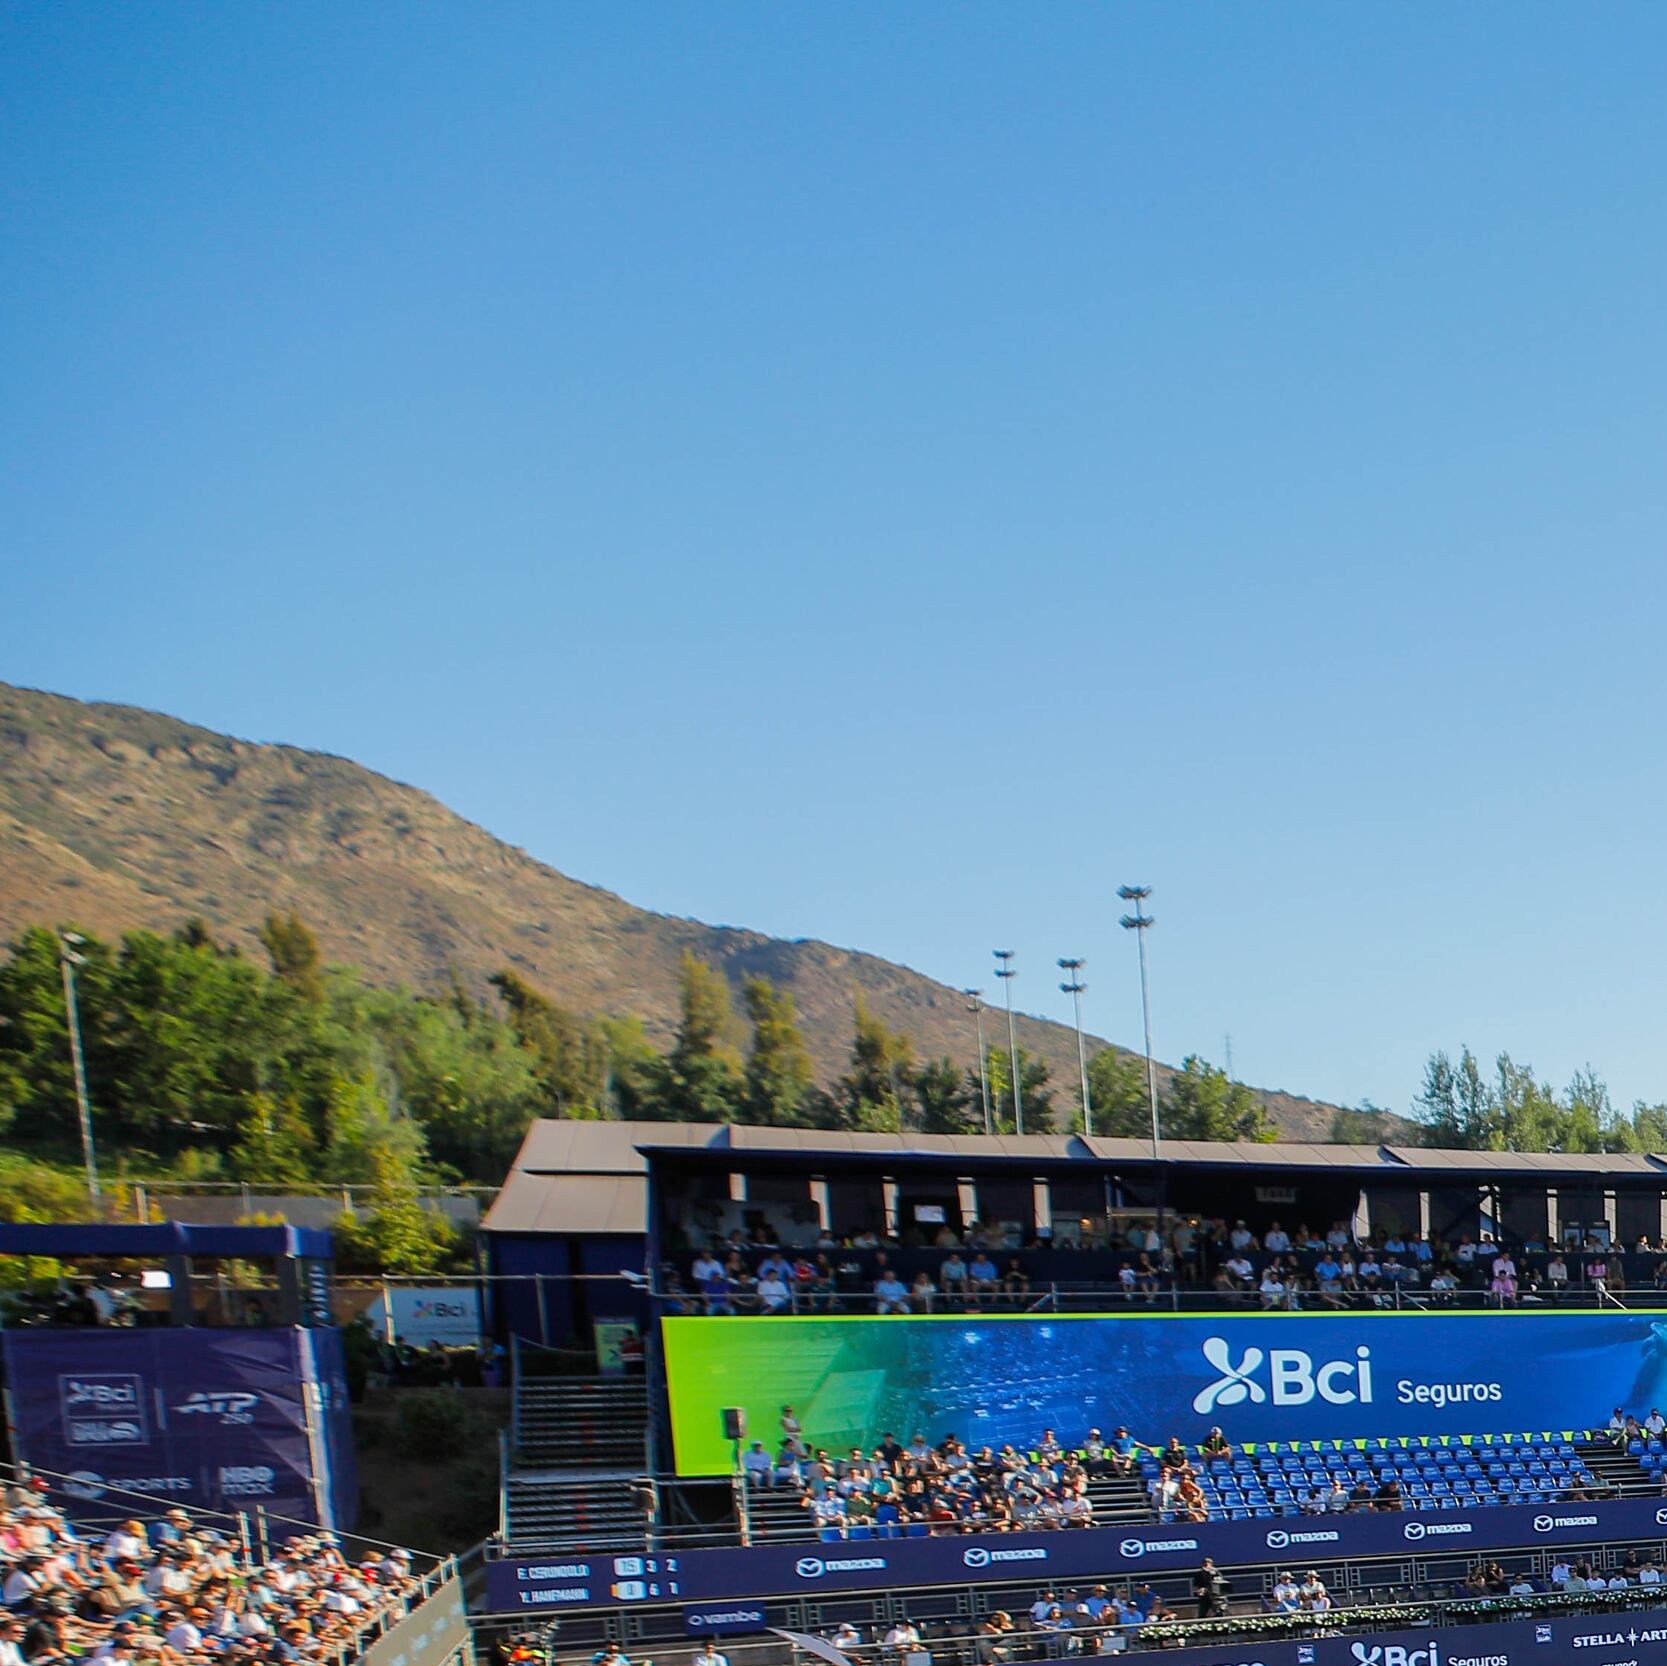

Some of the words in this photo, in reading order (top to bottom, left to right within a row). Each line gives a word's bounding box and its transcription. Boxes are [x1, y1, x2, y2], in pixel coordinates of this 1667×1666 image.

[1268, 1345, 1373, 1405] Bci
[1397, 1380, 1502, 1408] Seguros
[170, 1392, 259, 1414] ATP
[646, 1560, 656, 1573] 3
[666, 1559, 677, 1572] 2
[649, 1583, 659, 1596] 6
[669, 1582, 677, 1596] 1
[704, 1611, 762, 1625] vambe
[1573, 1633, 1625, 1648] STELLA
